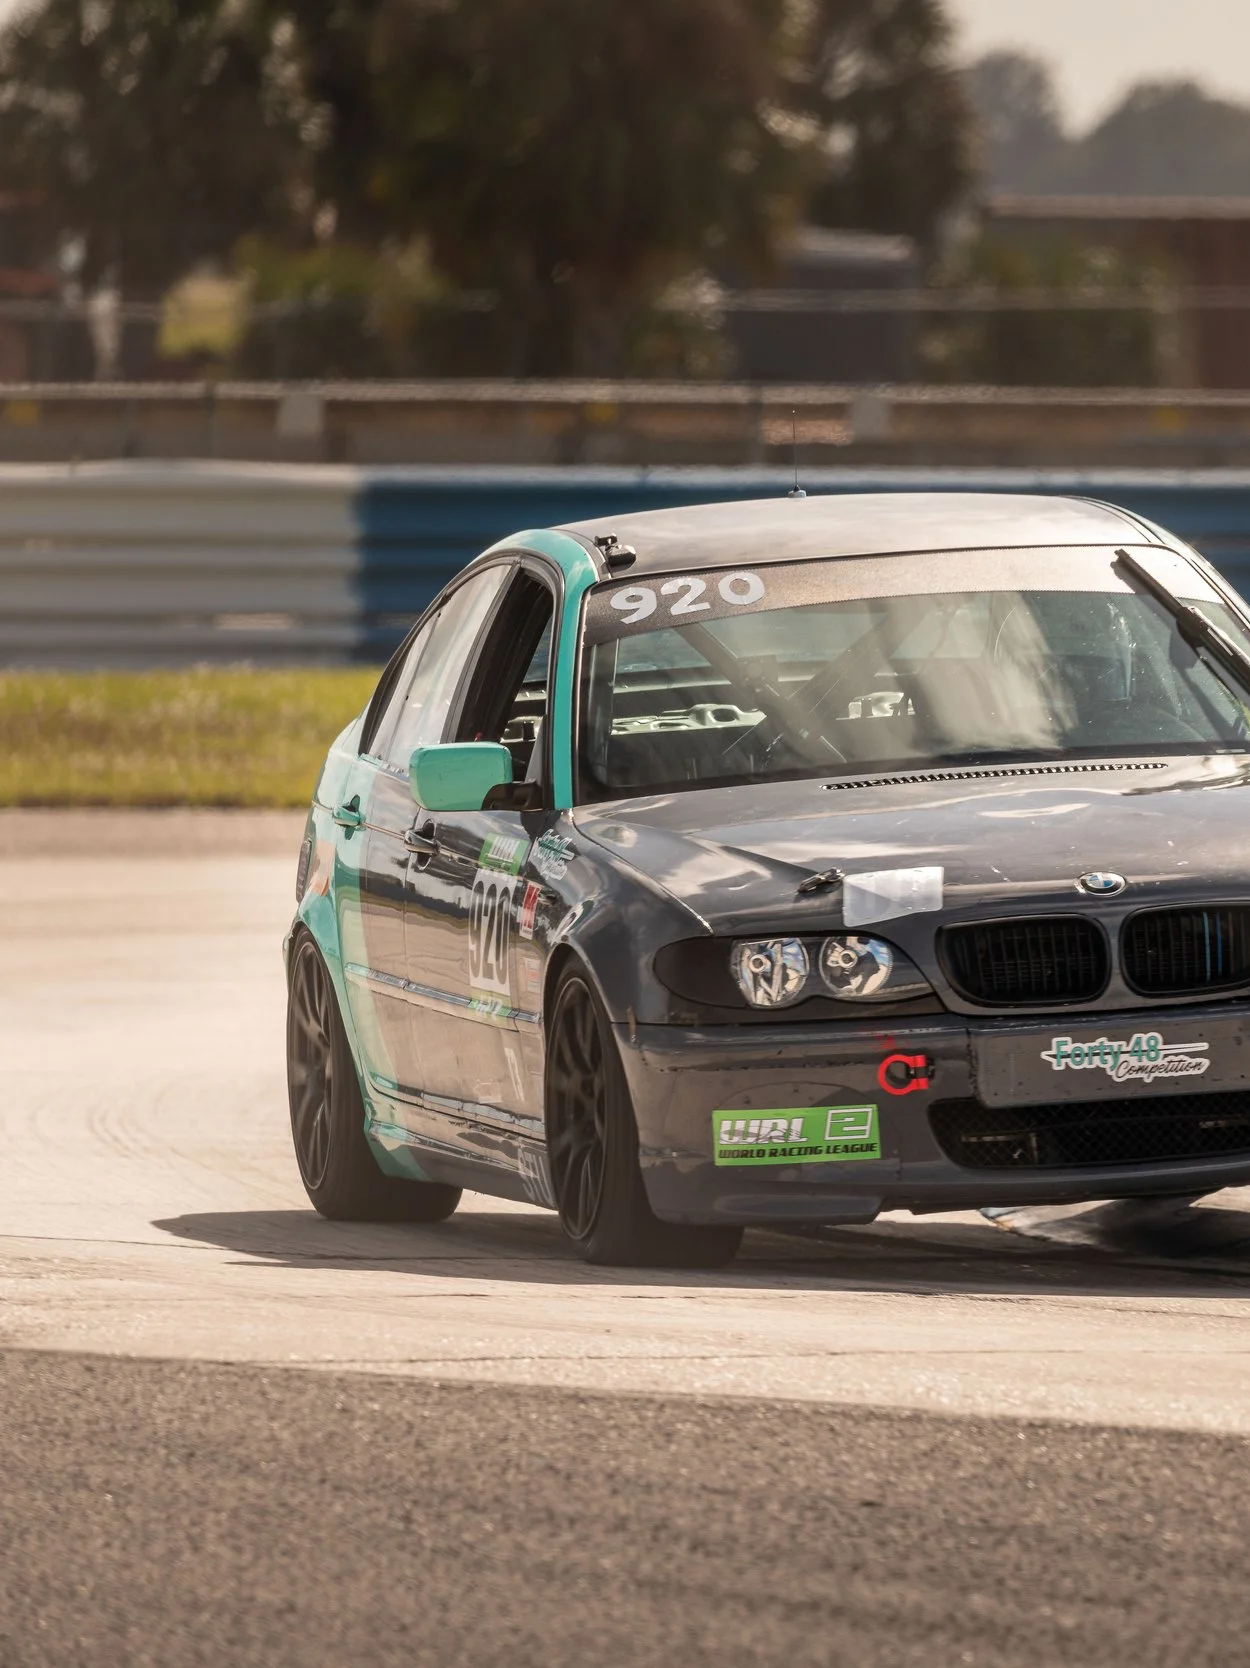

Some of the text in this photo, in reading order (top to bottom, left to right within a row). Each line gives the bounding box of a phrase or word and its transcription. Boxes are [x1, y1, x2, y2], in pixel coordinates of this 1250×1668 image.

[610, 571, 765, 625] 920
[469, 880, 511, 985] 920
[1055, 1035, 1161, 1071] Forty 48
[1116, 1059, 1203, 1078] Competition
[719, 1117, 808, 1145] WRL
[718, 1142, 878, 1159] WORLD RACING LEAGUE
